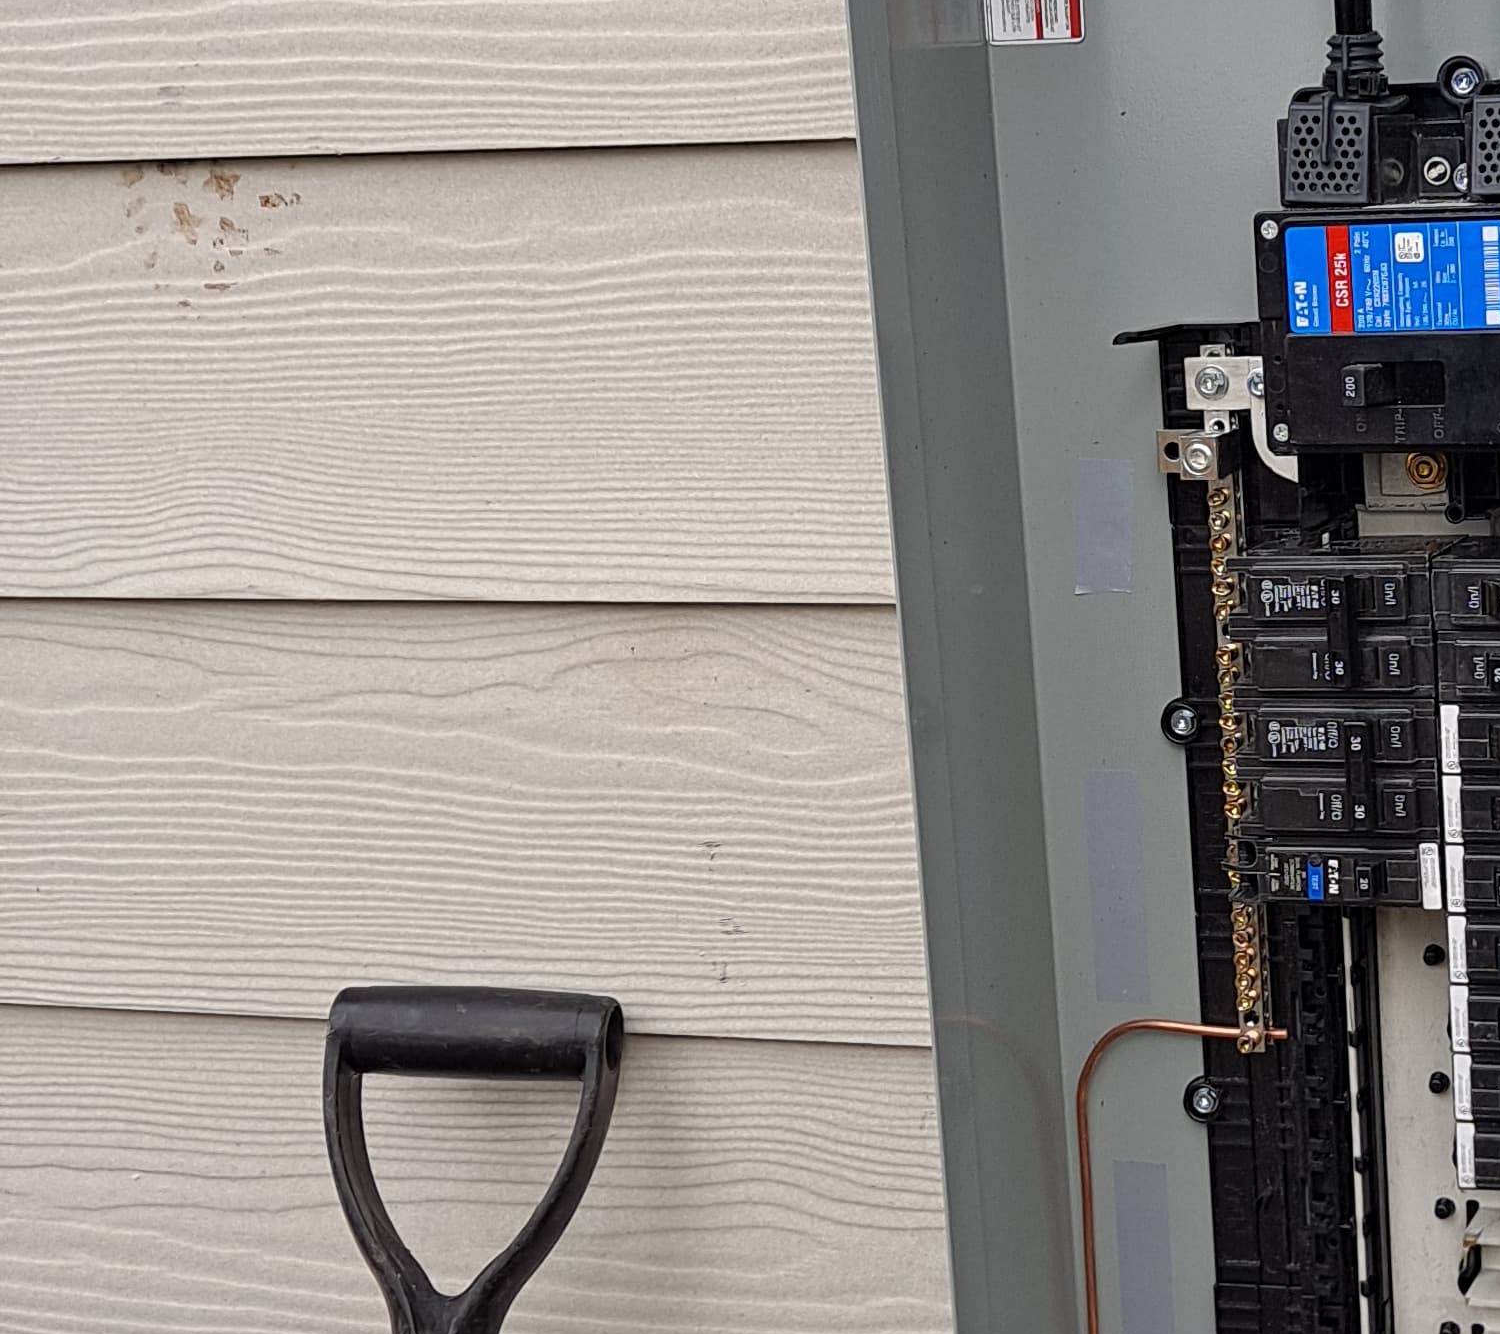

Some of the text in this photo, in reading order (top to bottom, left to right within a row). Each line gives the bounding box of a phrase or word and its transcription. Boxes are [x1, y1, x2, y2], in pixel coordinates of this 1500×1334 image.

[1334, 252, 1350, 307] CSR 25k
[1294, 281, 1309, 327] EATON
[1345, 376, 1356, 398] 200
[1394, 413, 1407, 444] TRIP
[1331, 589, 1341, 605] 30
[1334, 660, 1345, 676] 30
[1350, 736, 1362, 751] 30
[1354, 804, 1366, 819] 30
[1311, 874, 1319, 891] TEST
[1327, 859, 1340, 895] EATON
[1359, 877, 1369, 890] 20
